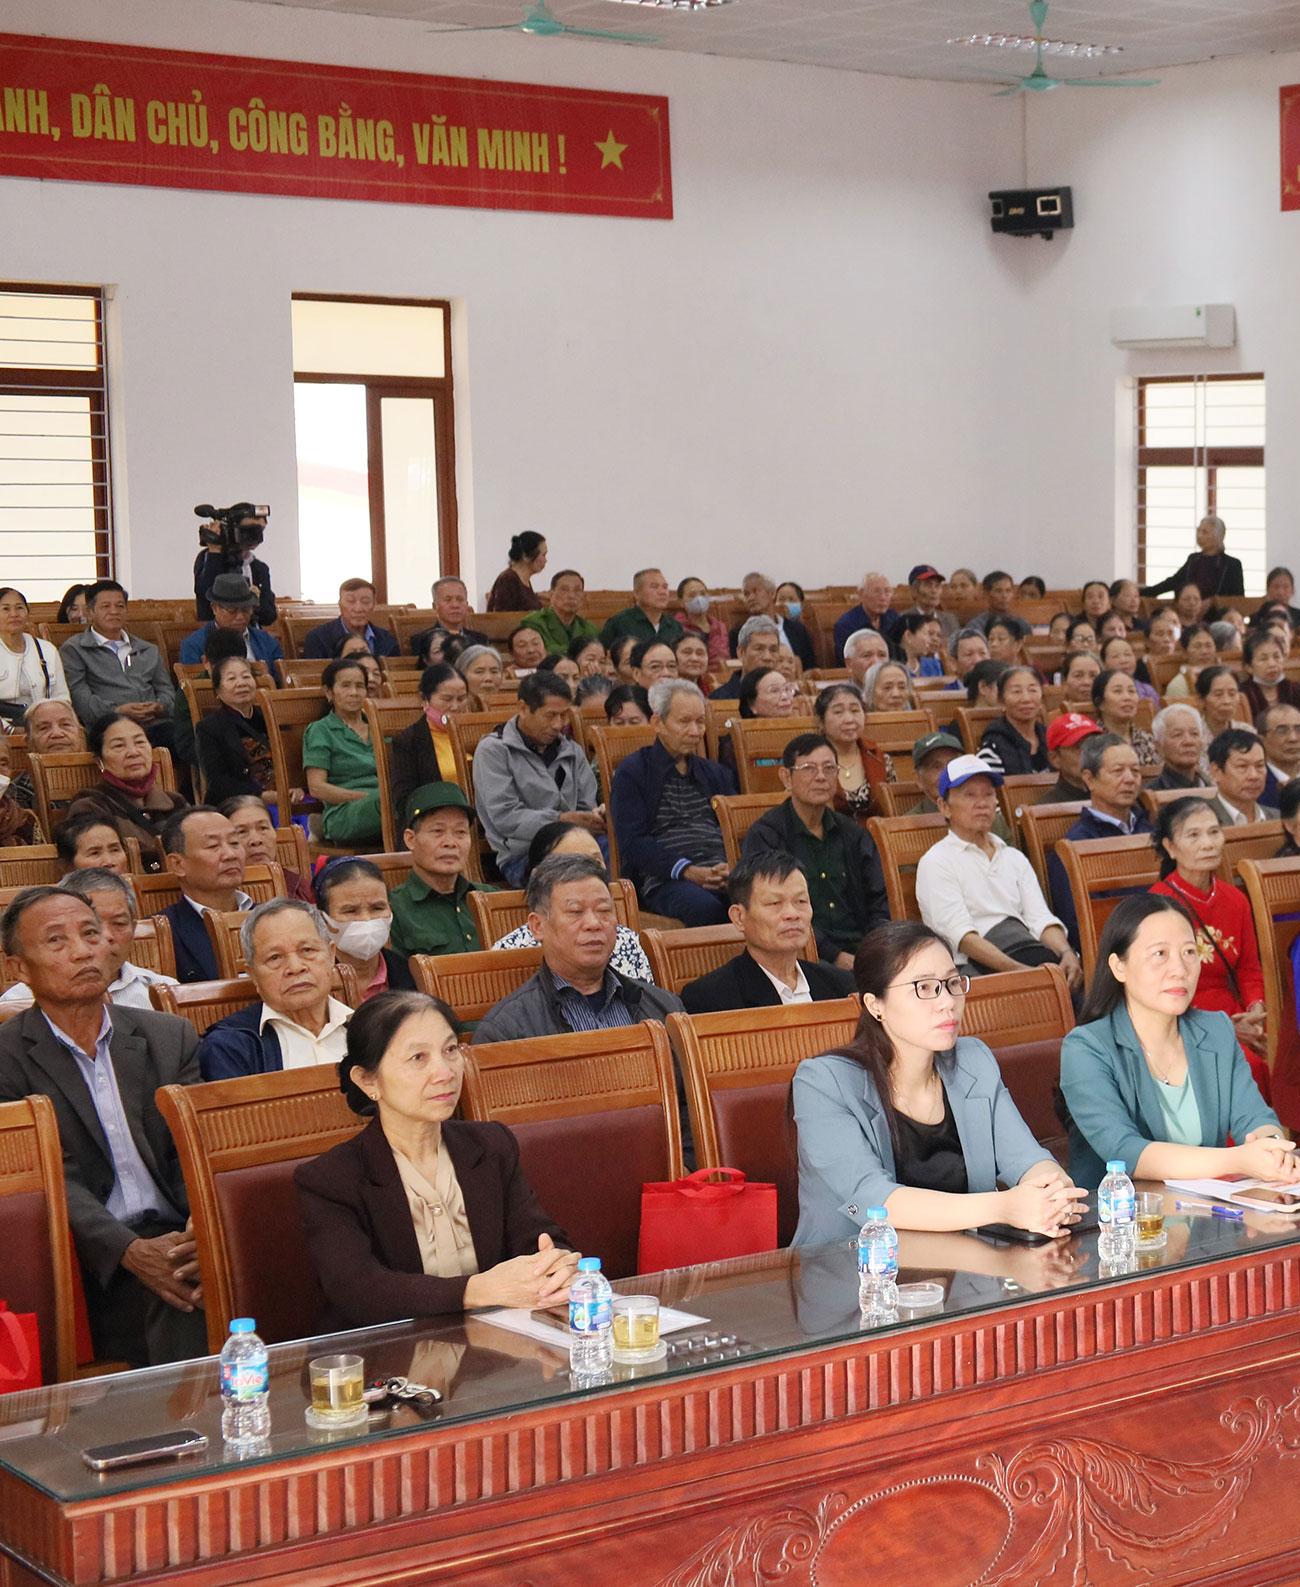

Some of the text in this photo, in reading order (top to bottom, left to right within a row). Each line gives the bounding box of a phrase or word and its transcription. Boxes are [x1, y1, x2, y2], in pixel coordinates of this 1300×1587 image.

[0, 86, 61, 142] NH,
[71, 83, 136, 142] DÂN
[146, 90, 219, 153] CHỦ,
[228, 97, 309, 157] CÔNG
[318, 102, 405, 168] BẰNG,
[412, 115, 469, 168] VĂN
[477, 128, 550, 174] MINH
